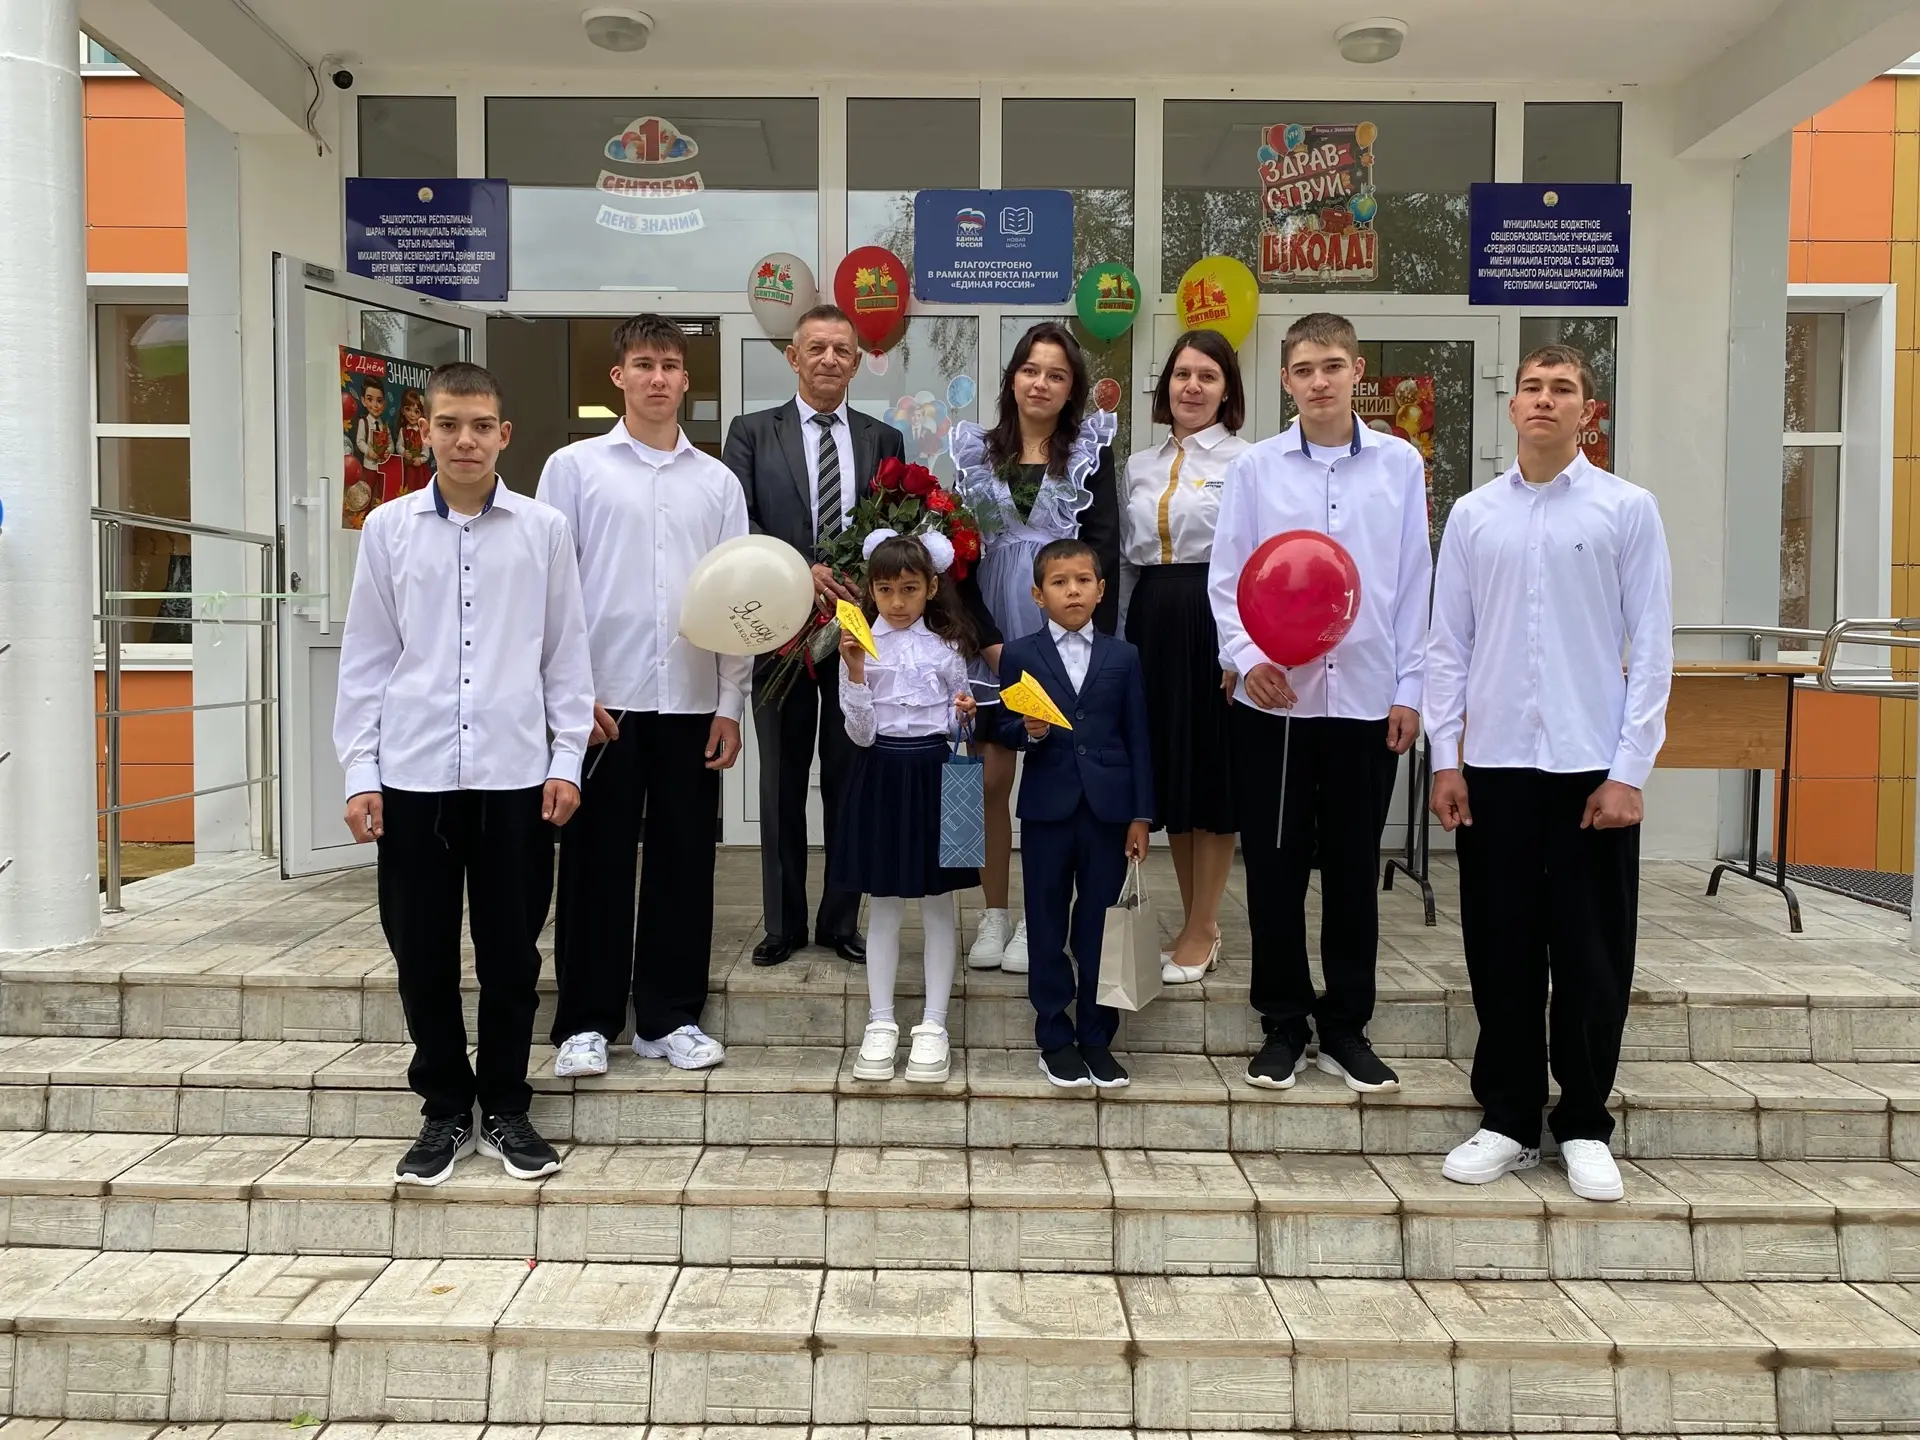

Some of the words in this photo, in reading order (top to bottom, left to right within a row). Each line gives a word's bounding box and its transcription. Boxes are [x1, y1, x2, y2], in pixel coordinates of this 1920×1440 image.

[639, 119, 659, 161] 1
[1265, 143, 1347, 183] ЗДРАВ-
[602, 175, 698, 197] СЕНТЯБРЯ
[600, 210, 637, 229] ДЕНЬ
[641, 212, 699, 232] ЗНАНИЙ
[1503, 220, 1558, 230] МУНИЦИПАЛЬНОЕ
[1560, 220, 1601, 230] БЮДЖЕТНОЕ
[366, 227, 386, 236] ШАРАН
[412, 227, 450, 237] МУНИЦИПАЛЬ
[1490, 232, 1570, 242] ОБЩЕОБРАЗОВАТЕЛЬНОЕ
[1571, 232, 1612, 242] УЧРЕЖДЕНИЕ
[1263, 233, 1374, 272] ШКОЛА!
[1484, 244, 1516, 254] «СРЕДНЯЯ
[1517, 244, 1596, 254] ОБЩЕОБРАЗОВАТЕЛЬНАЯ
[1596, 244, 1619, 253] ШКОЛА
[381, 251, 403, 260] ЕГОРОВ
[476, 251, 496, 260] БЕЛЕМ
[954, 261, 1032, 269] БЛАГОУСТРОЕНО
[1490, 256, 1512, 266] ИМЕНИ
[1512, 256, 1543, 266] МИХАИЛА
[1544, 256, 1572, 266] ЕГОРОВА
[1575, 256, 1581, 266] С.
[1582, 256, 1614, 266] БАЗГИЕВО
[419, 264, 456, 274] МУНИЦИПАЛЬ
[458, 264, 481, 274] БЮДЖЕТ
[1478, 268, 1537, 278] МУНИЦИПАЛЬНОГО
[1538, 267, 1562, 278] РАЙОНА
[1564, 267, 1602, 278] ШАРАНСКИЙ
[1603, 267, 1624, 278] РАЙОН
[950, 281, 993, 289] «ЕДИНАЯ
[1504, 280, 1544, 290] РЕСПУБЛИКИ
[1545, 280, 1597, 290] БАШКОРТОСТАН»
[345, 354, 353, 368] С
[356, 356, 385, 374] Днём
[1352, 382, 1379, 396] НЕМ
[1344, 589, 1354, 620] 1
[734, 600, 763, 620] Я
